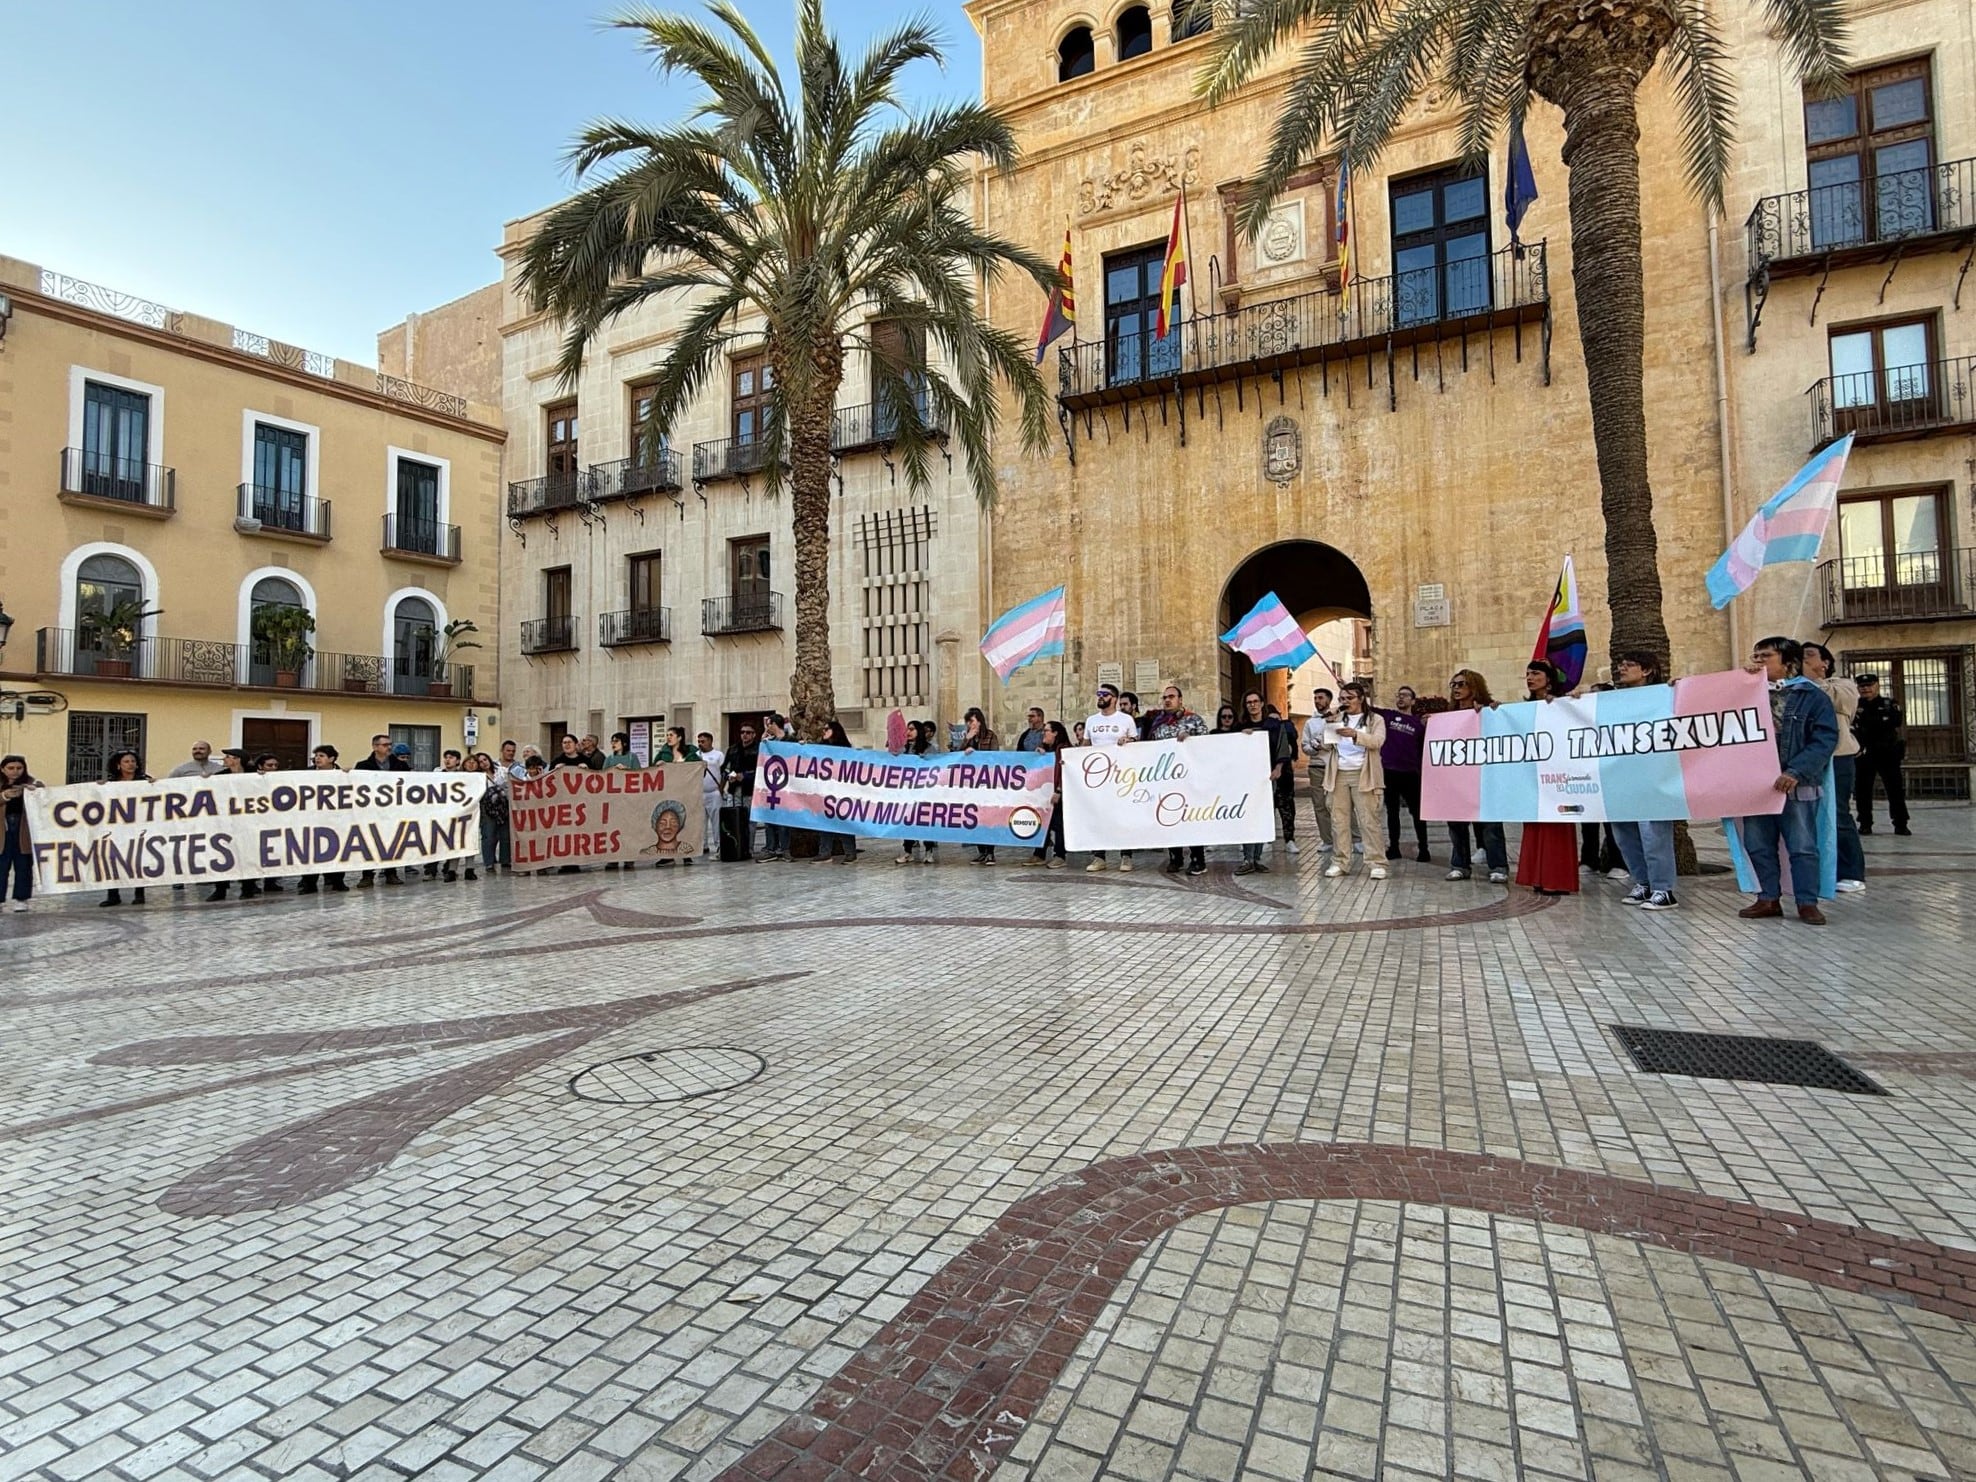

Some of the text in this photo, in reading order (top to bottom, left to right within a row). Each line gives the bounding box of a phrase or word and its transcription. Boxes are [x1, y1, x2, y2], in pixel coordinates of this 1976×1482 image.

[1092, 725, 1111, 733] UGT
[1428, 707, 1767, 766] VISIBILIDAD TRANSEXUAL
[511, 770, 665, 801] ENS VOLEM
[795, 756, 1027, 791] LAS MUJERES TRANS
[1082, 752, 1188, 797] Orgullo
[53, 789, 218, 828] CONTRA
[228, 796, 270, 815] LES
[823, 795, 978, 830] SON MUJERES
[1133, 789, 1154, 804] De
[1156, 793, 1249, 827] Ciudad
[512, 802, 610, 832] VIVES I
[259, 814, 472, 867] ENDAVANT
[514, 830, 621, 864] LLIURES
